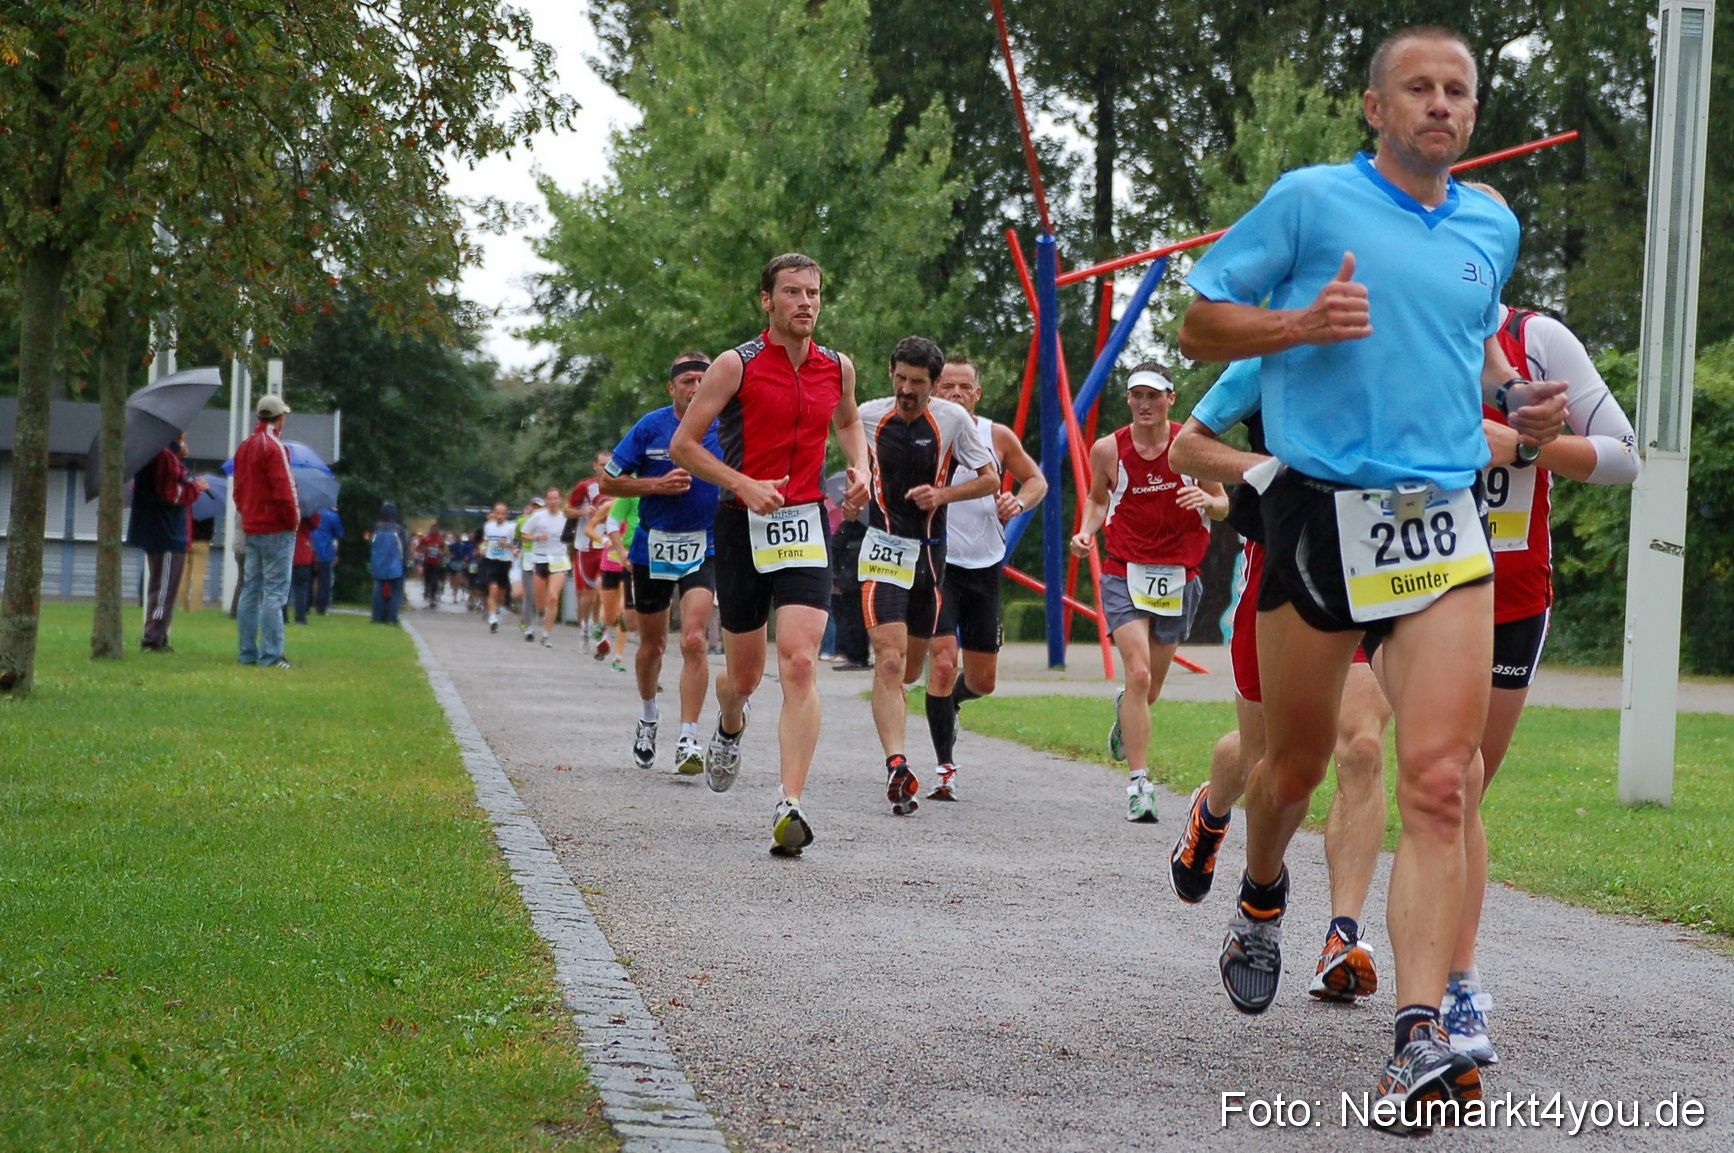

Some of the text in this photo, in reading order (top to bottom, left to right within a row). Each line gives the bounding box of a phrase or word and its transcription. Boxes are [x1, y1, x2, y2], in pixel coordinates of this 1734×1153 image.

[1486, 466, 1510, 508] 9
[766, 519, 809, 546] 650
[1370, 511, 1457, 567] 208
[653, 543, 700, 562] 2157
[777, 549, 804, 559] Franz
[869, 564, 898, 576] Werner
[1145, 576, 1168, 597] 76
[1391, 571, 1449, 595] Günter
[1491, 664, 1528, 676] asics
